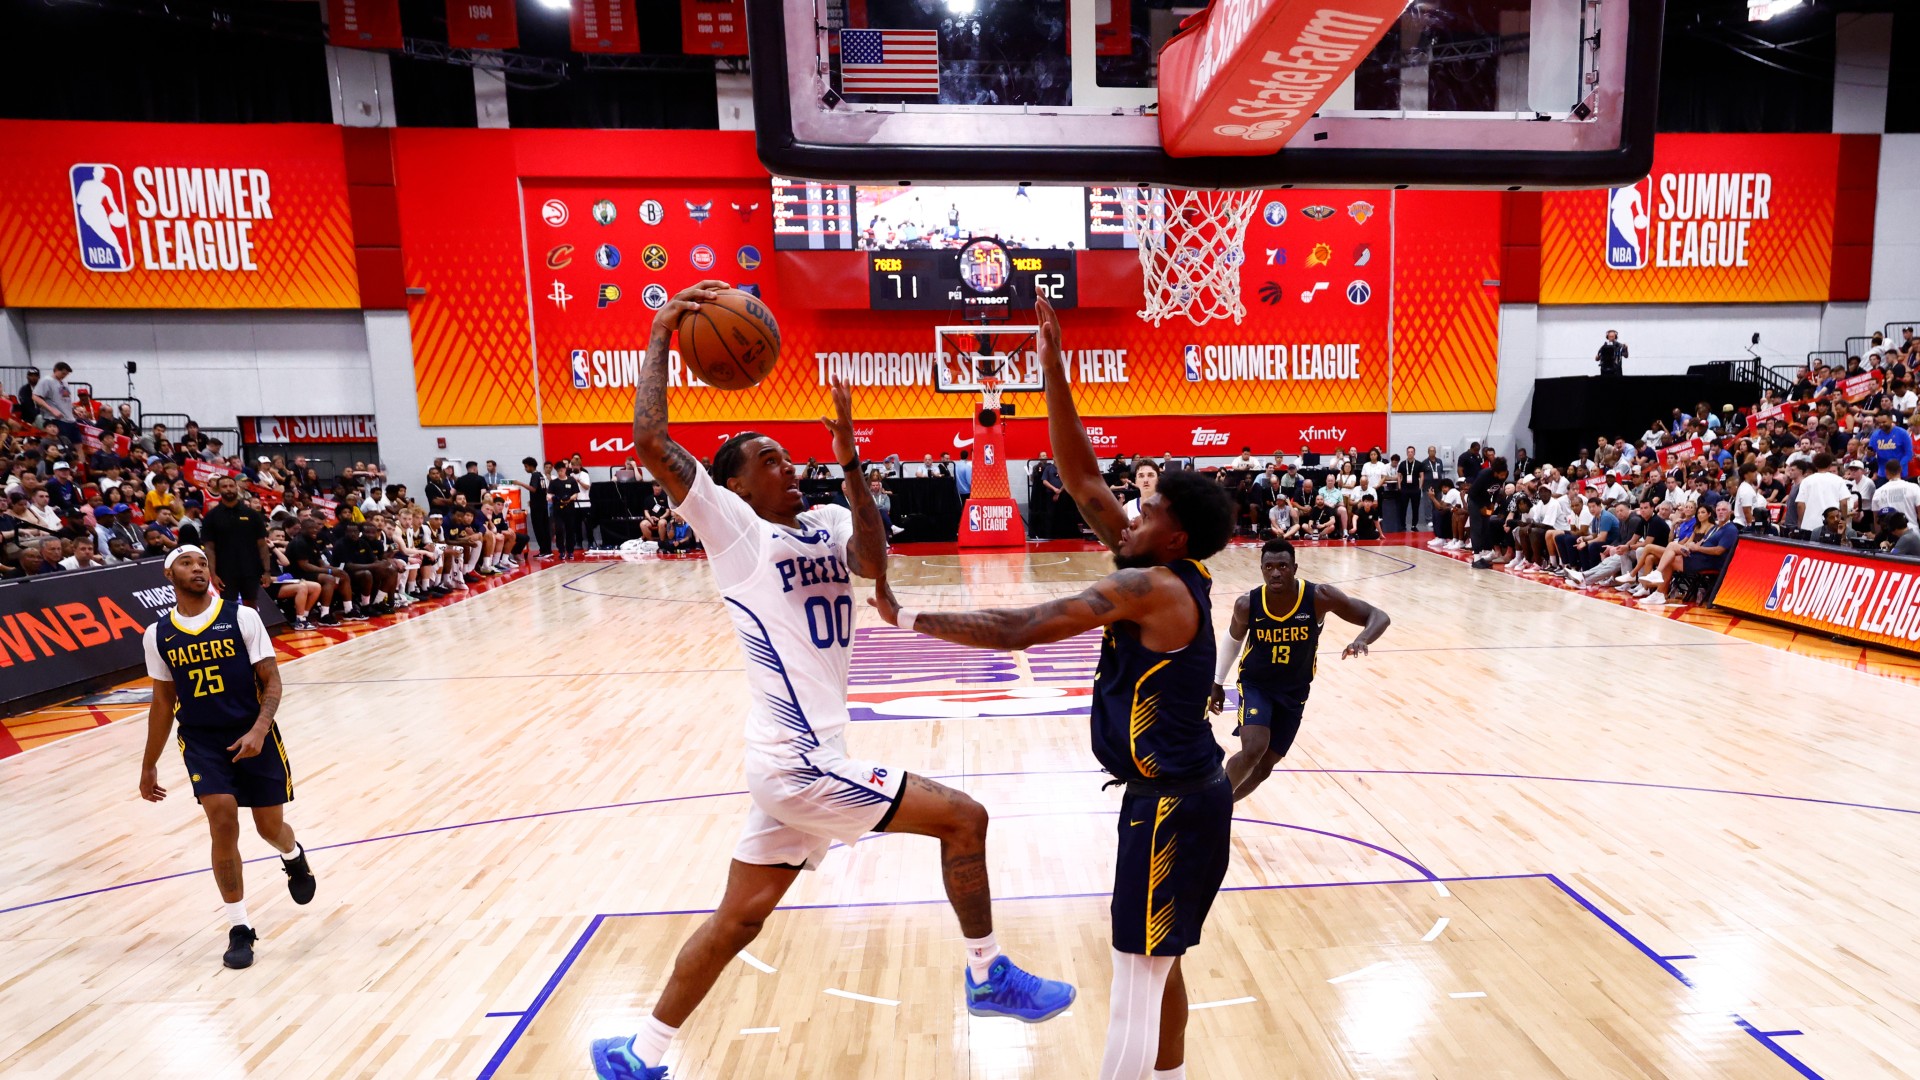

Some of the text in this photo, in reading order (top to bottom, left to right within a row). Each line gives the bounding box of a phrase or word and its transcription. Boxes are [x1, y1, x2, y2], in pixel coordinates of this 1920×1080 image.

[132, 166, 273, 220] SUMMER
[826, 189, 833, 200] 2
[1658, 173, 1771, 220] SUMMER
[811, 205, 819, 216] 2
[827, 205, 834, 216] 2
[812, 220, 820, 231] 2
[88, 246, 115, 265] NBA
[139, 221, 258, 272] LEAGUE
[1612, 247, 1632, 263] NBA
[1655, 221, 1750, 267] LEAGUE
[874, 259, 902, 271] 76ERS
[888, 275, 917, 298] 71
[592, 350, 683, 388] SUMR
[1079, 349, 1129, 383] HERE
[1204, 344, 1360, 382] SUMMER LEAGUE
[1299, 425, 1347, 442] xfinity
[982, 506, 1013, 518] SUMMER
[982, 519, 1008, 531] LEAGUE
[1781, 557, 1875, 628] SUMMER
[804, 595, 852, 649] 00
[1256, 626, 1309, 643] PACERS
[167, 639, 236, 668] PACERS
[1271, 645, 1291, 664] 13
[188, 665, 225, 697] 25
